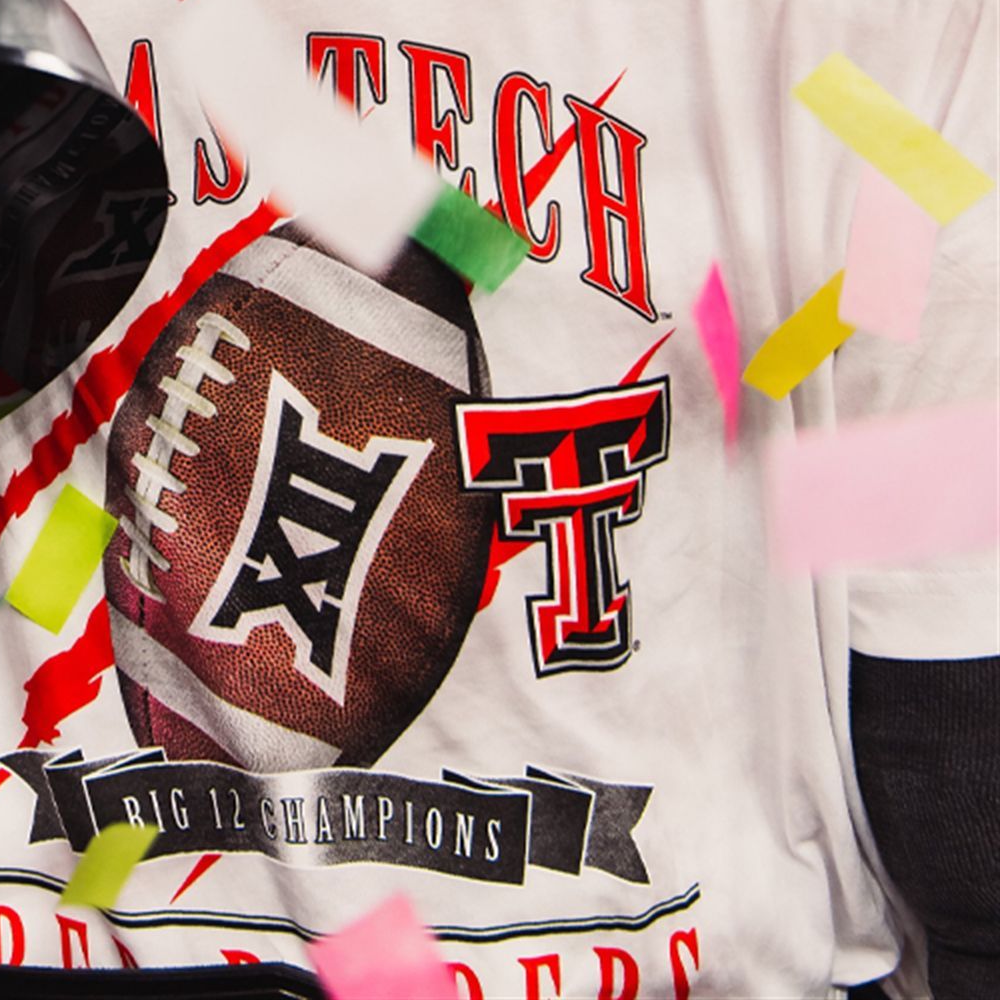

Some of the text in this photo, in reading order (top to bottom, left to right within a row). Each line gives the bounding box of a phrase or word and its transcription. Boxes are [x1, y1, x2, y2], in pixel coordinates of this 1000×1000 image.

[122, 787, 502, 863] BIG 12 CHAMPIONS
